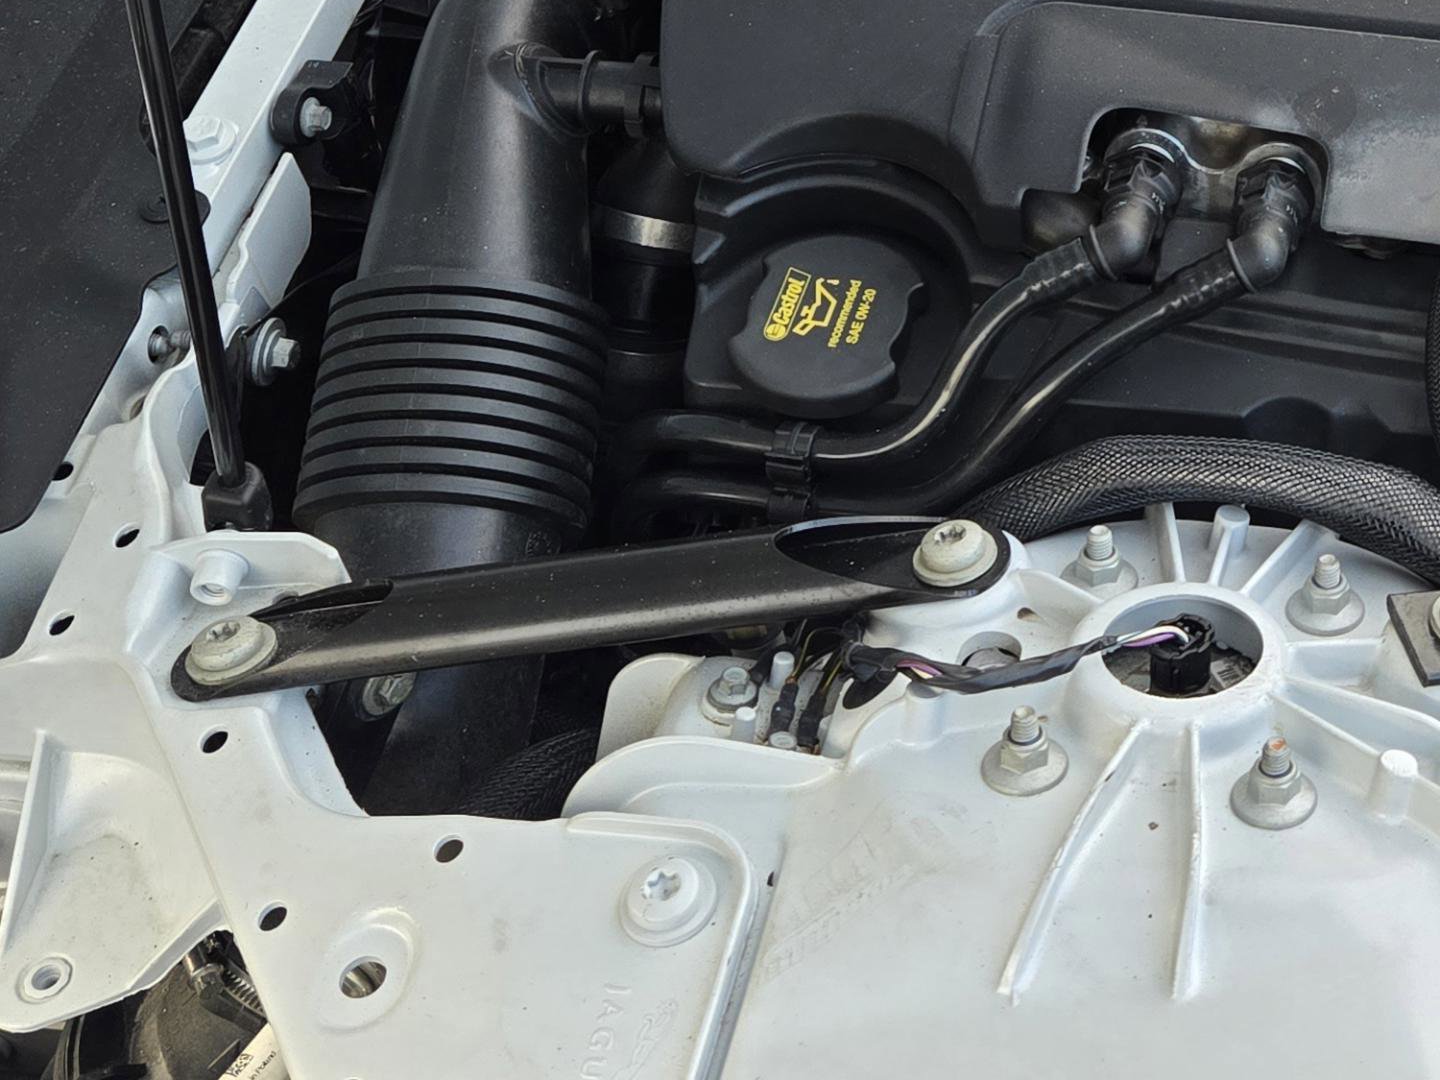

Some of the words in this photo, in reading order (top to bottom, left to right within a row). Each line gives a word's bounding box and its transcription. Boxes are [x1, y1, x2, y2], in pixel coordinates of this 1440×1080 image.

[772, 277, 805, 325] Castrol
[827, 279, 862, 348] recommended
[845, 321, 864, 344] SAE
[855, 288, 877, 320] 0W-20
